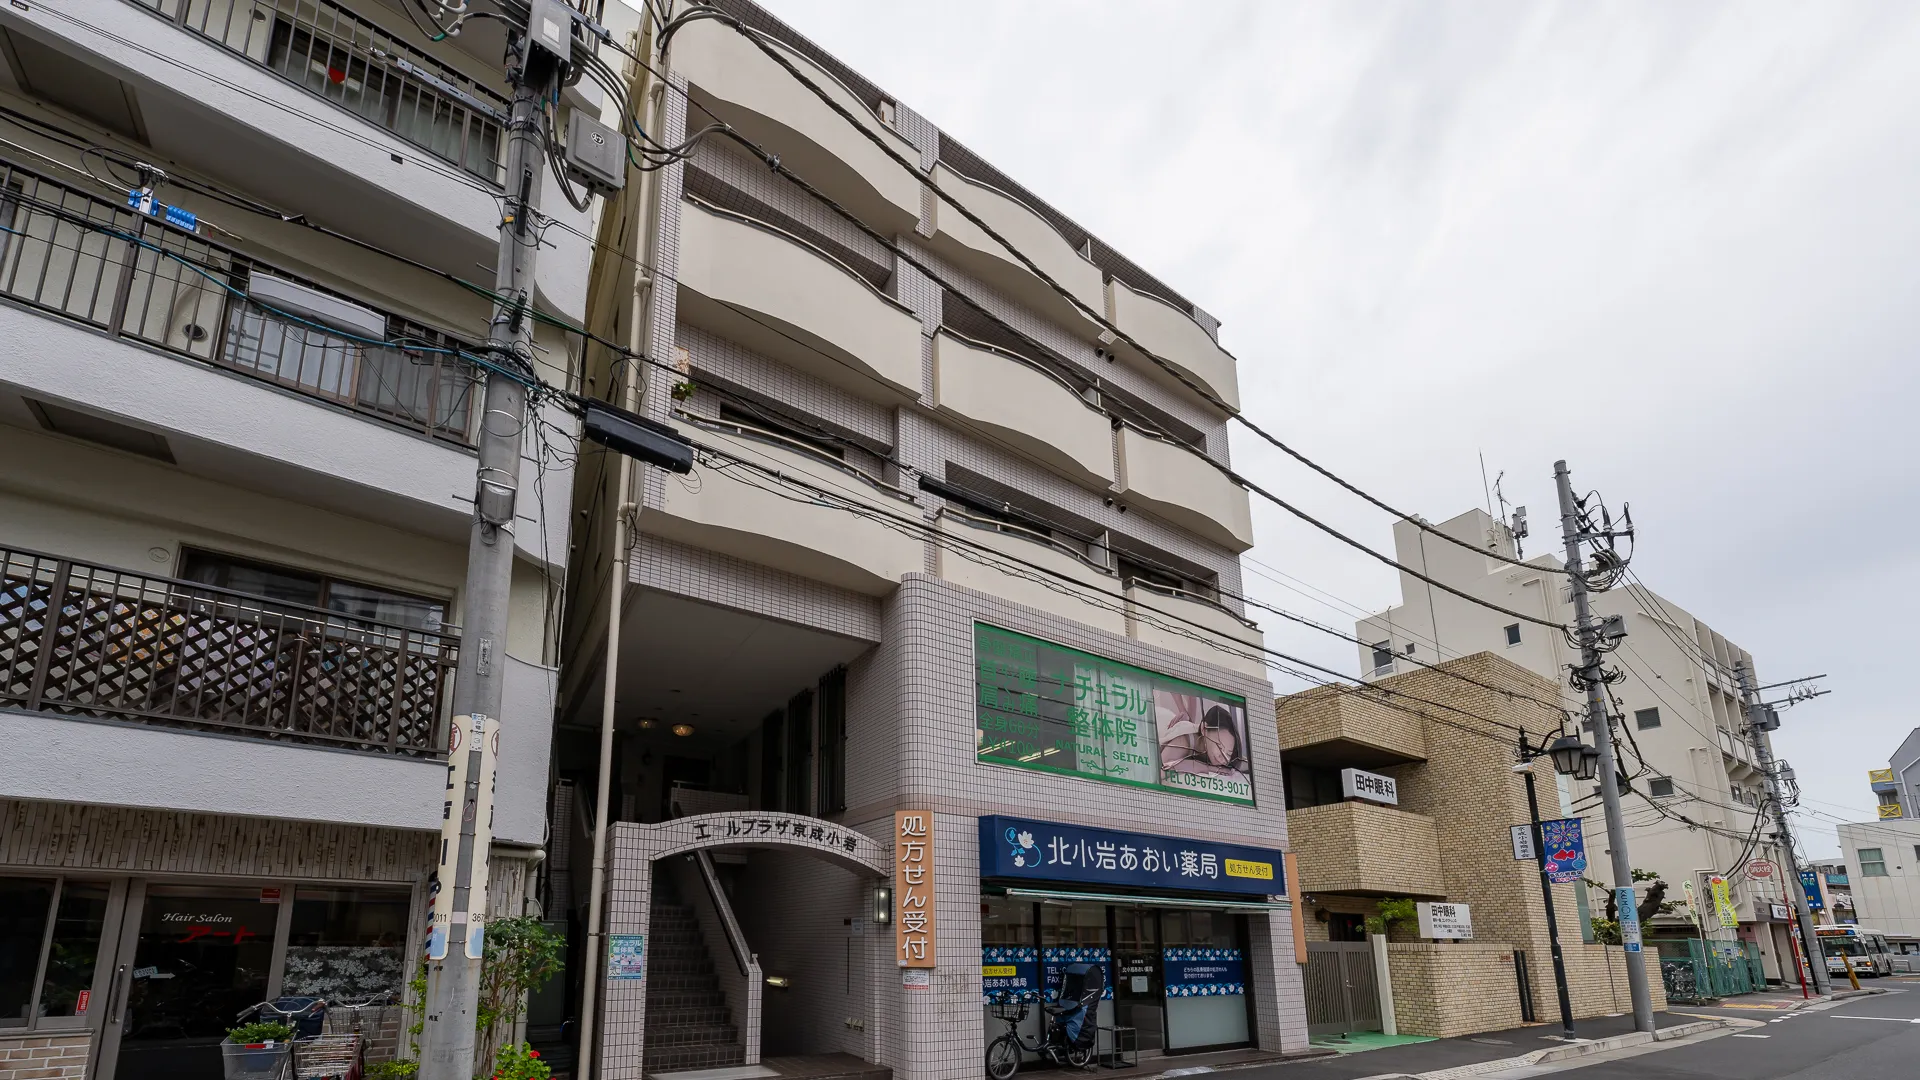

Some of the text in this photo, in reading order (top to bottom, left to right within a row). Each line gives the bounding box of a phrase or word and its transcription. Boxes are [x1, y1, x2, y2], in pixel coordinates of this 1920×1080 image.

[1050, 668, 1147, 716] ナチュラル
[979, 711, 1040, 740] 全身60分
[1066, 706, 1138, 748] 整体院
[1055, 739, 1150, 766] NATURAL SEITAI
[1164, 769, 1250, 797] TEL 03-6753-9017
[1355, 774, 1395, 798] 田中眼科
[1047, 835, 1270, 880] 北小岩あおい薬局 処方せん受付
[900, 815, 929, 962] 処方せん受付
[161, 912, 233, 924] Hair Salon
[1431, 905, 1456, 918] 田中眼科
[1619, 889, 1631, 920] KUMON
[177, 925, 257, 946] アート
[610, 939, 642, 947] ナチュラル
